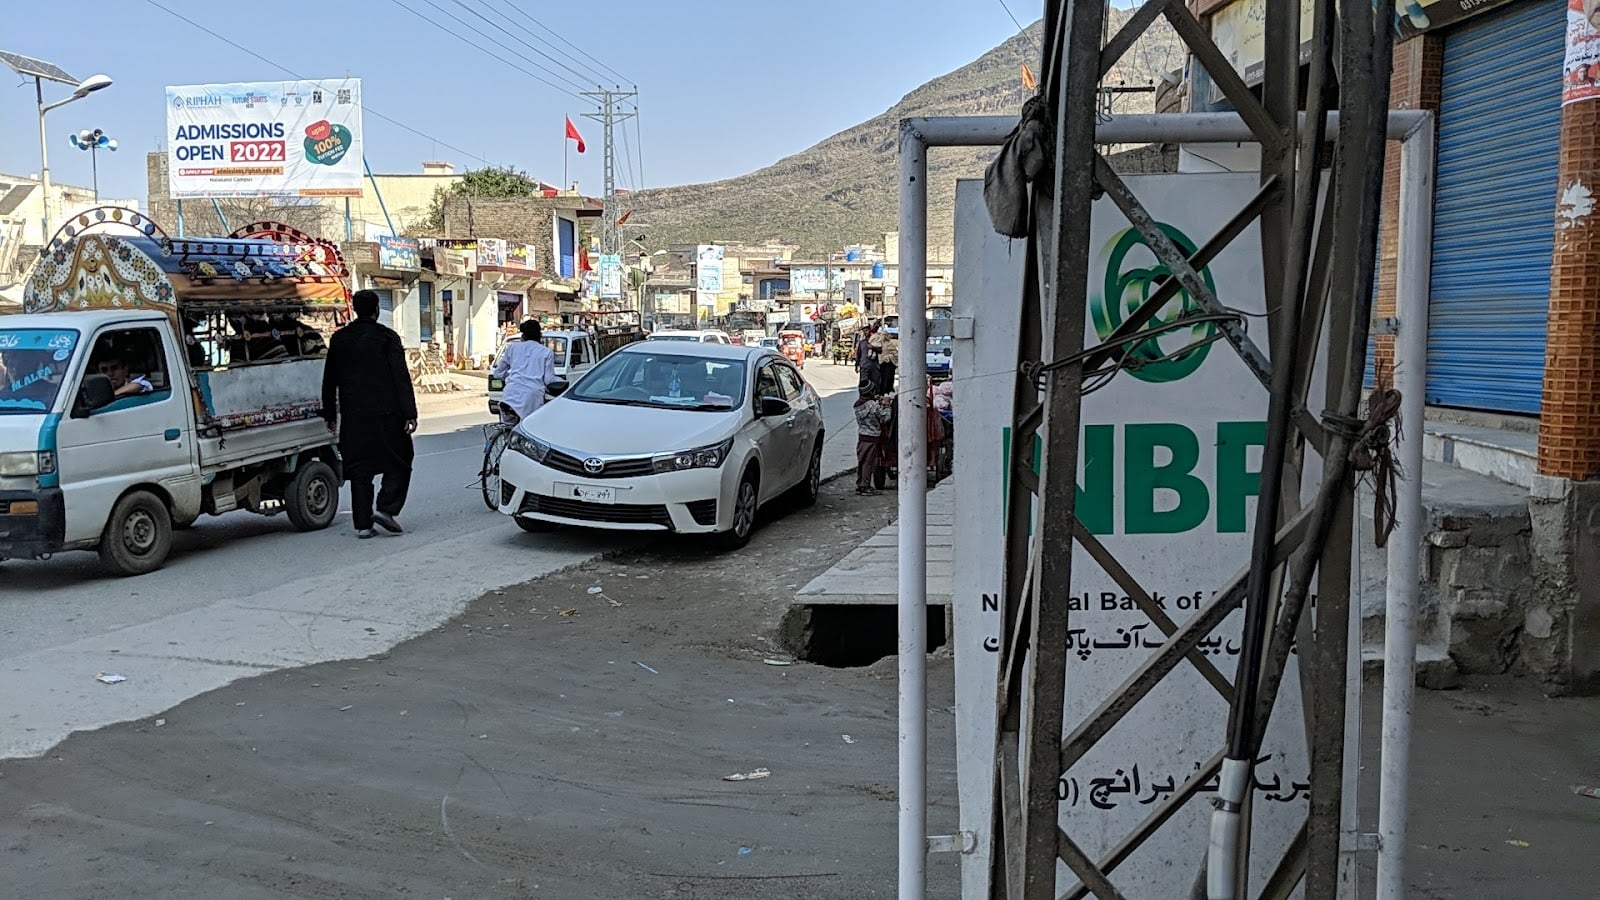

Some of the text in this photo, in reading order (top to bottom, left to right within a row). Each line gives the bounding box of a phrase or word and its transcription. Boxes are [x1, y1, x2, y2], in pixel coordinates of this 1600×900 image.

[186, 95, 222, 106] RIPHAH
[232, 96, 249, 104] FUTURE
[175, 122, 285, 141] ADMISSIONS
[175, 143, 283, 161] OPEN 2022
[313, 134, 342, 155] 100%
[1176, 592, 1202, 610] of
[1093, 622, 1150, 649] آف
[1089, 763, 1175, 810] برانچ
